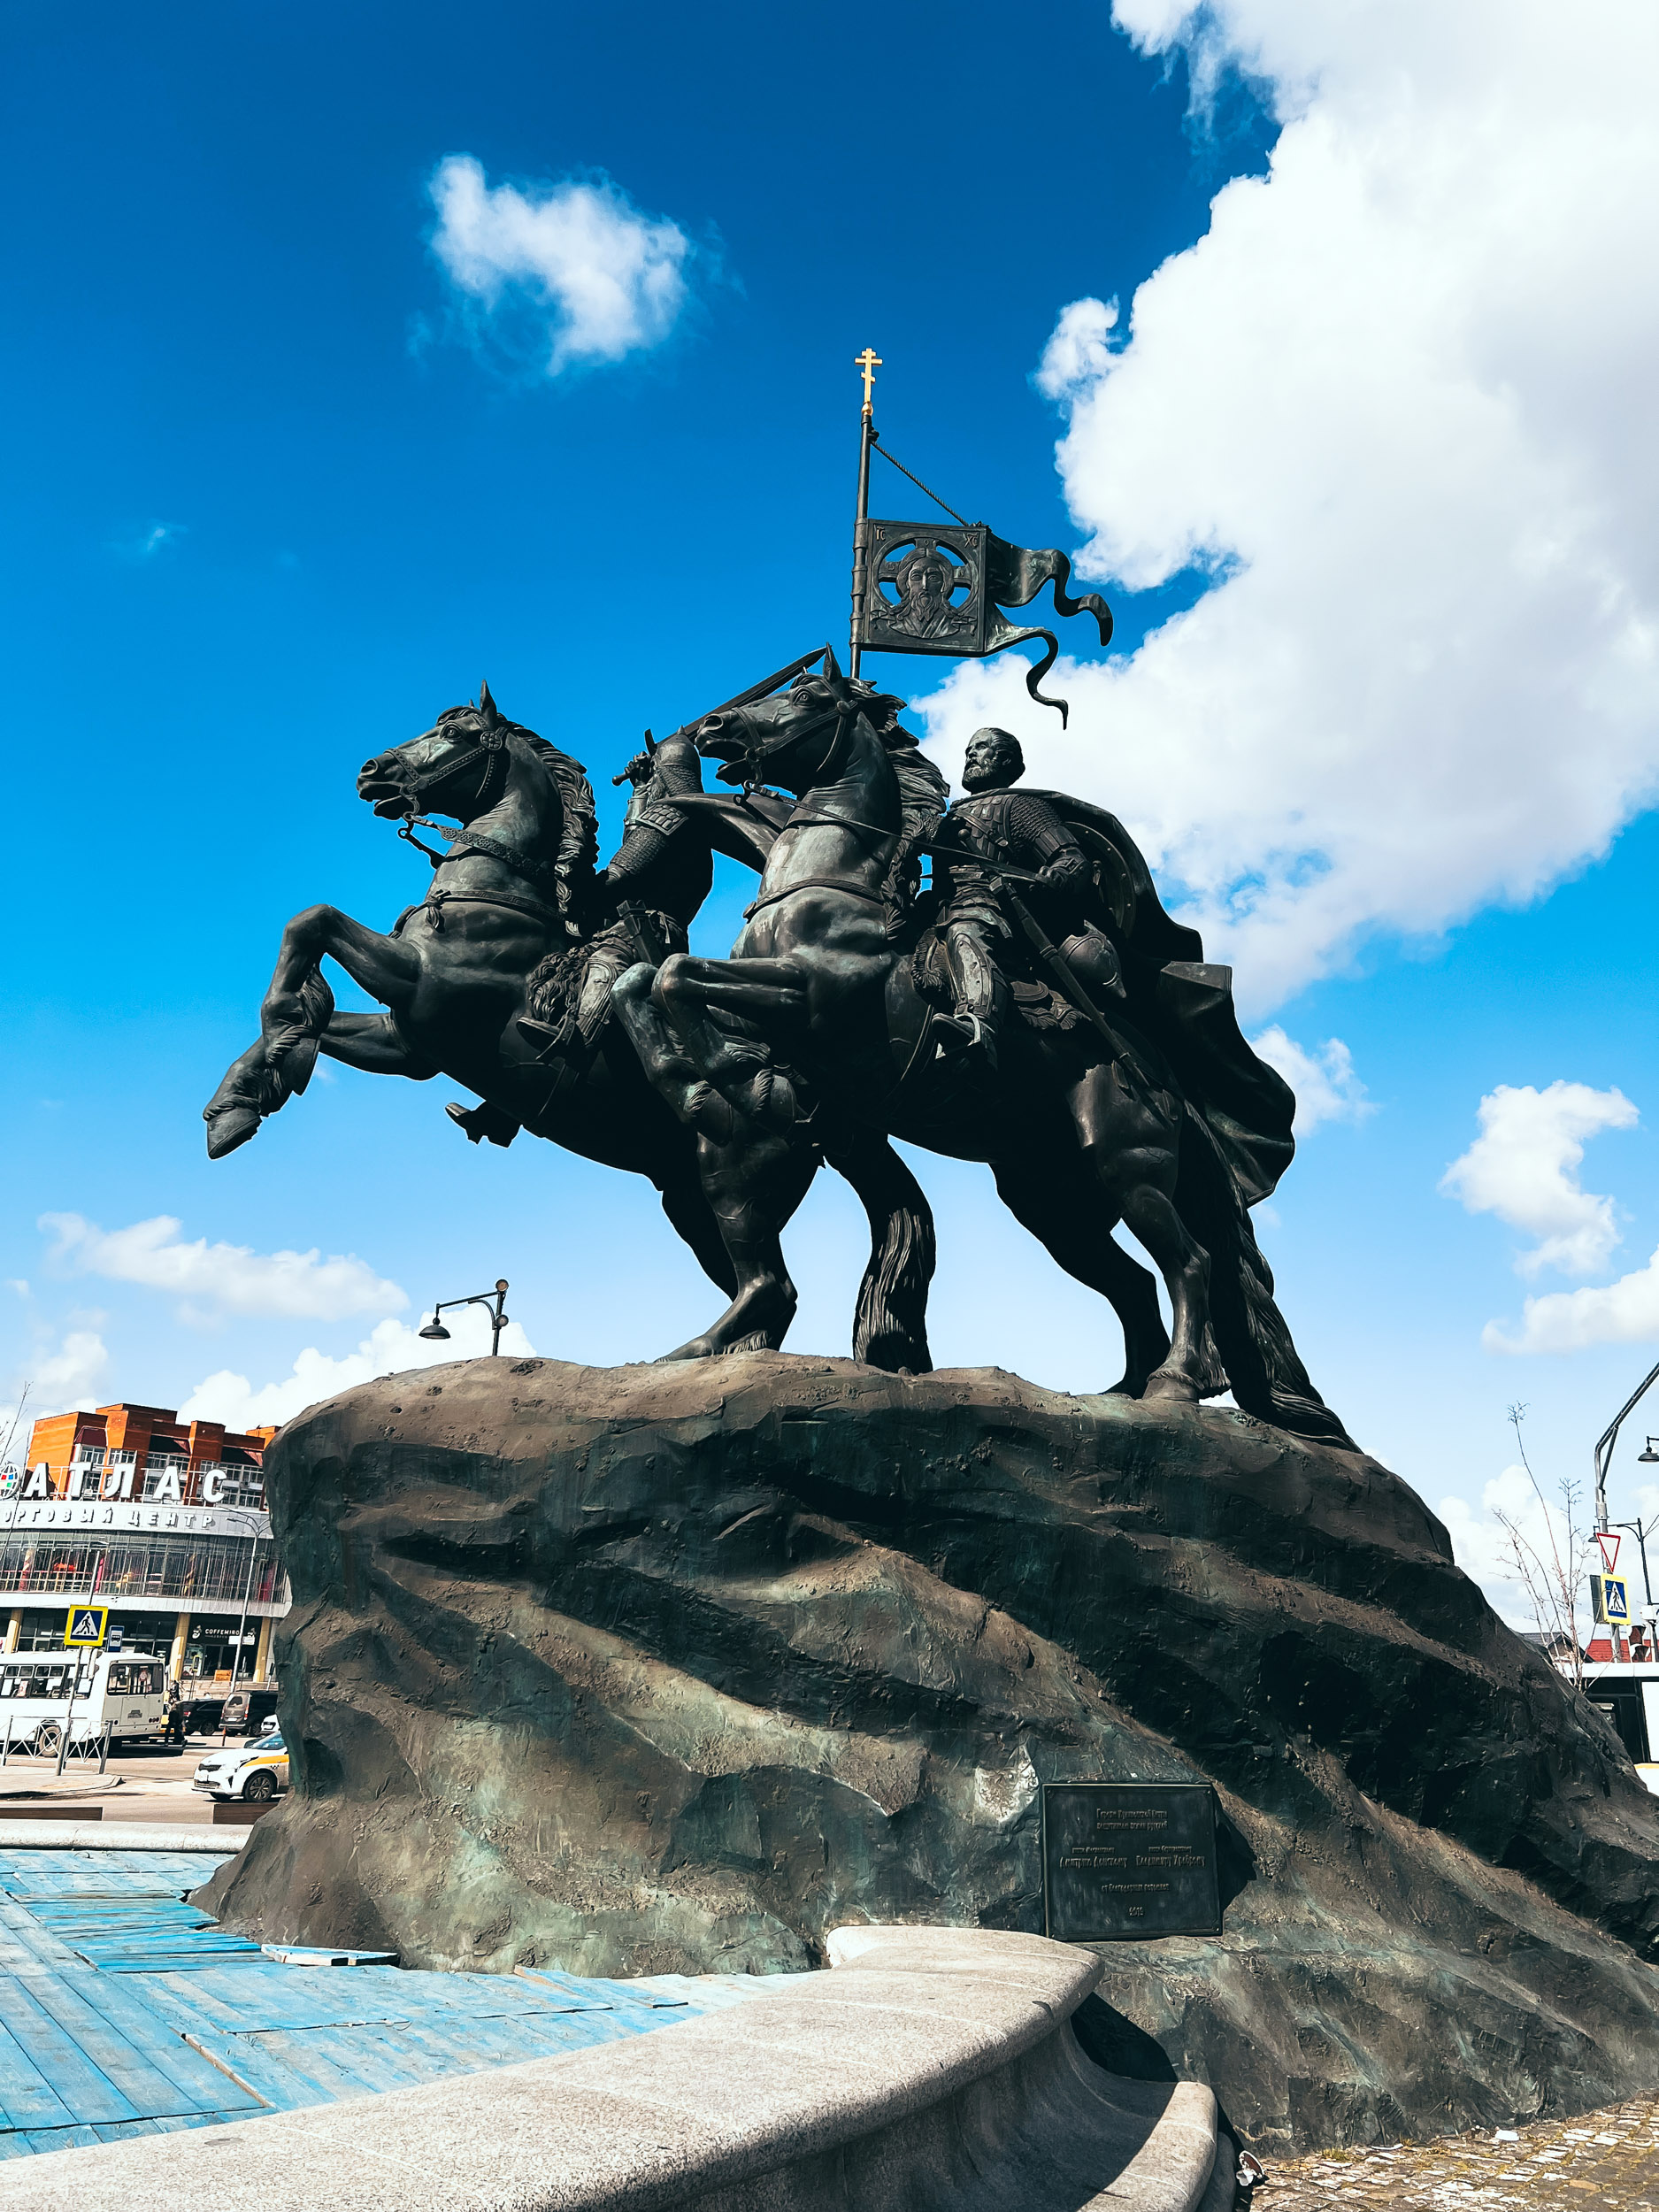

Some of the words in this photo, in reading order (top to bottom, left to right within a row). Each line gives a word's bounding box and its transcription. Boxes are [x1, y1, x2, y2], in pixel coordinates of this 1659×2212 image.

[23, 1462, 227, 1503] АТЛАС
[4, 1507, 113, 1524] ОРГОВЫЙ
[128, 1510, 216, 1528] ЦЕНТР
